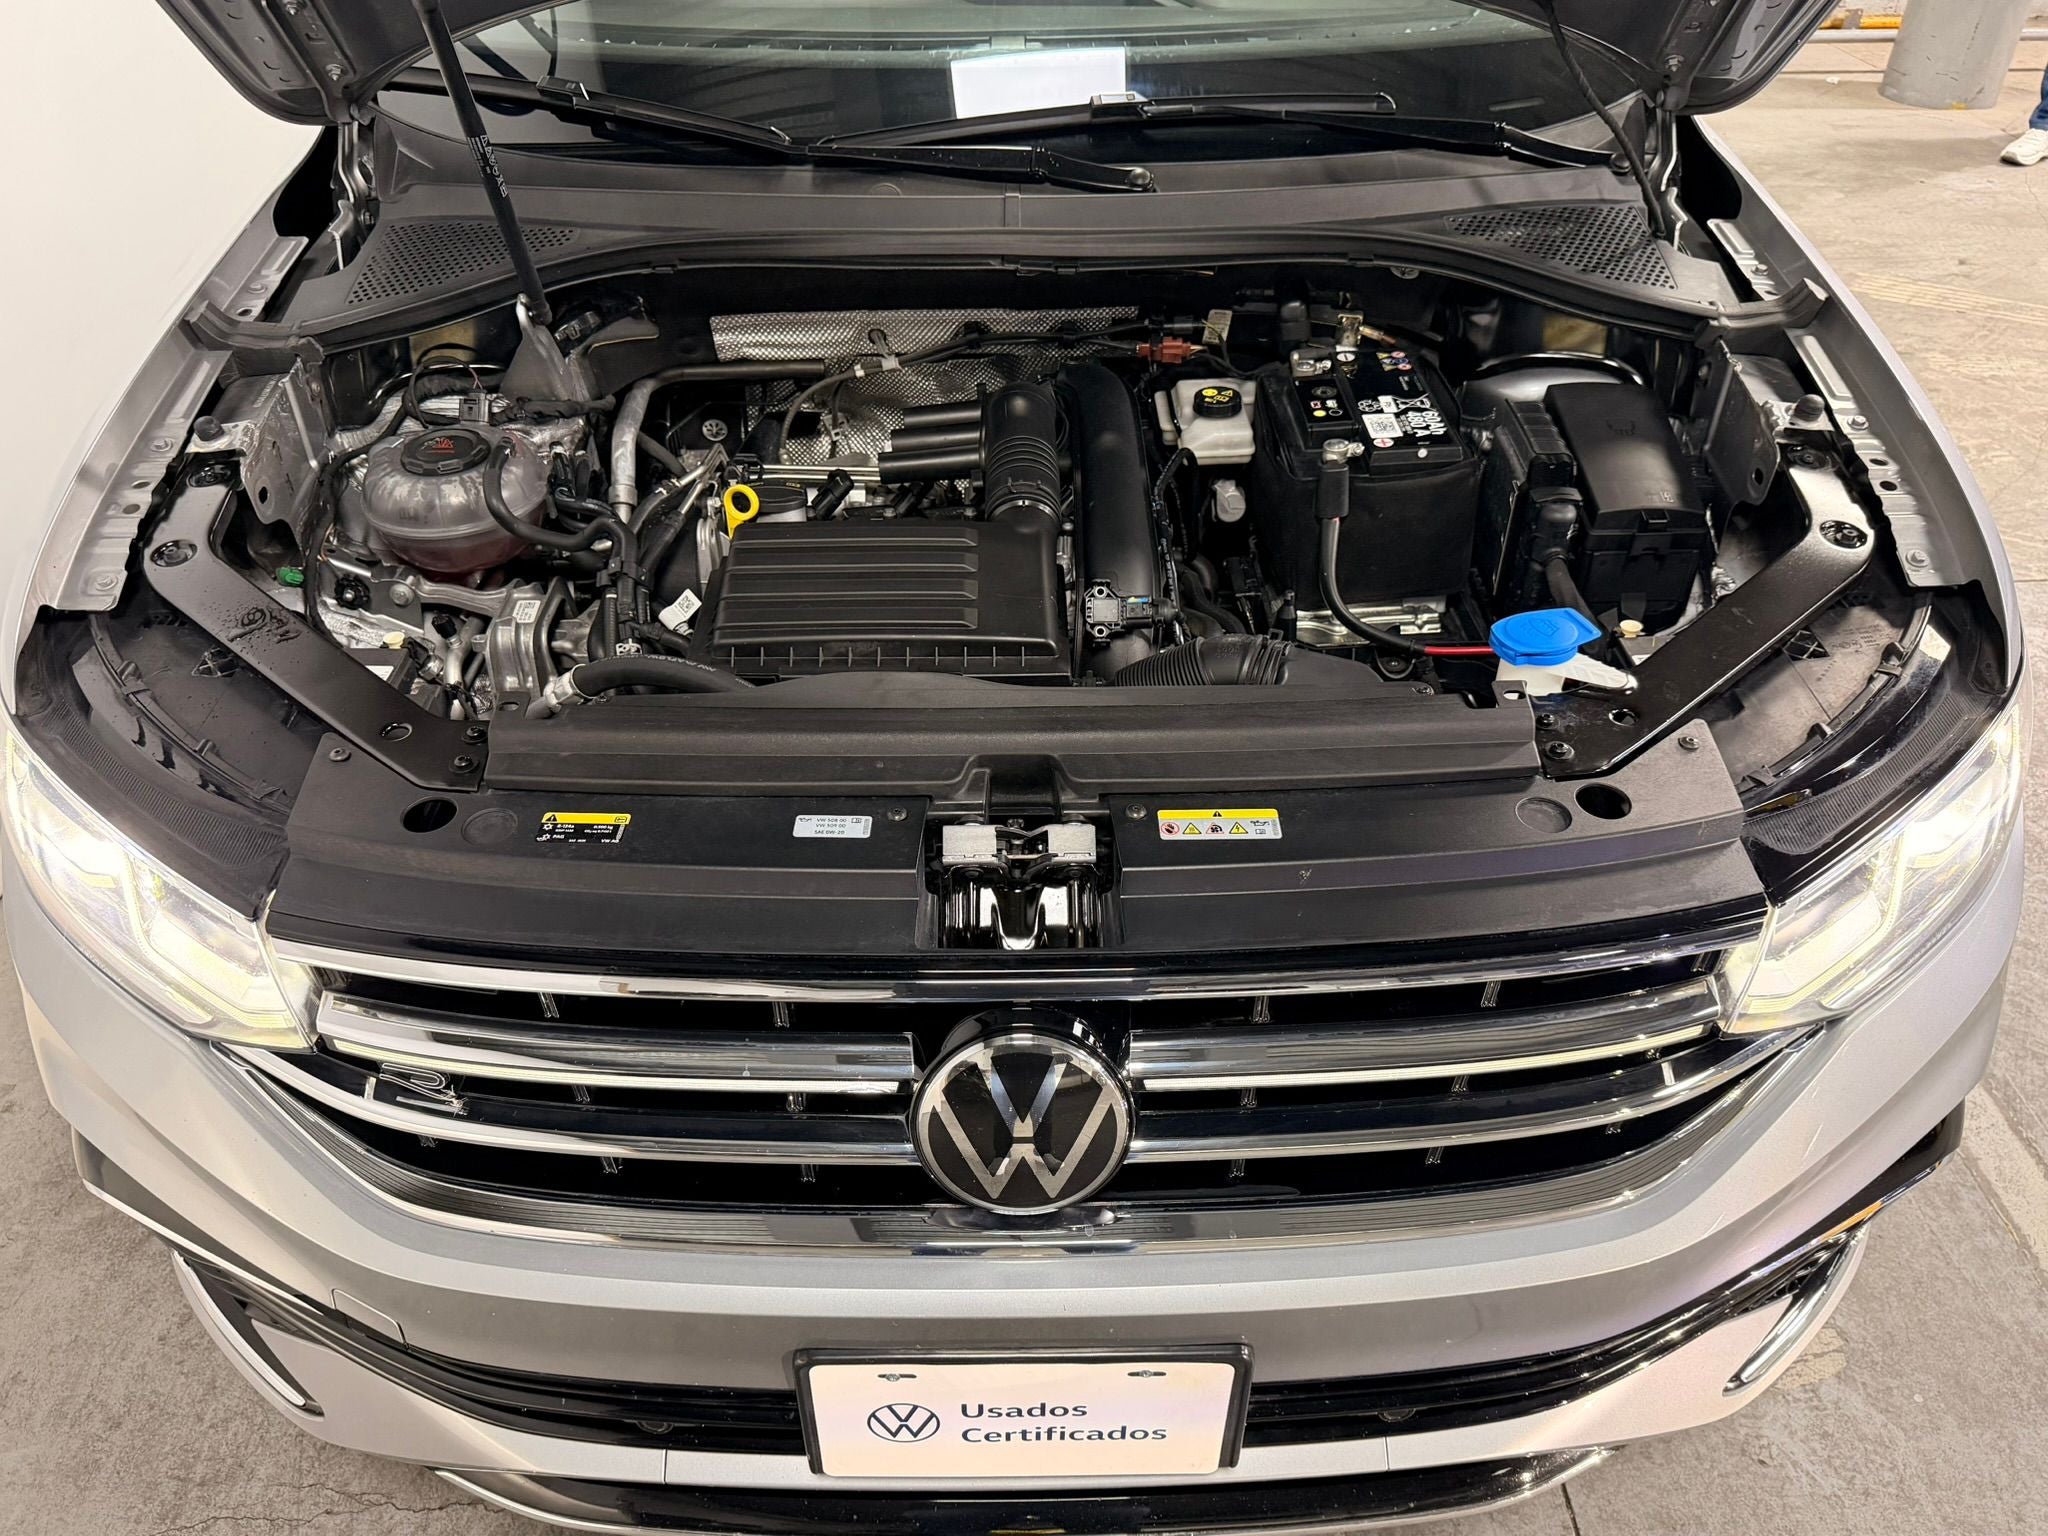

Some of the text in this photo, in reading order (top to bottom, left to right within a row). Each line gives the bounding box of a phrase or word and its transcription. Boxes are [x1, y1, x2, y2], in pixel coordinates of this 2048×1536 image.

[1406, 411, 1427, 428] 480
[1422, 411, 1448, 435] 60Ah
[1413, 429, 1431, 437] A
[927, 1048, 1121, 1203] VW
[961, 1402, 1088, 1419] Usados
[867, 1402, 940, 1443] VW
[961, 1425, 1168, 1443] Certificados
